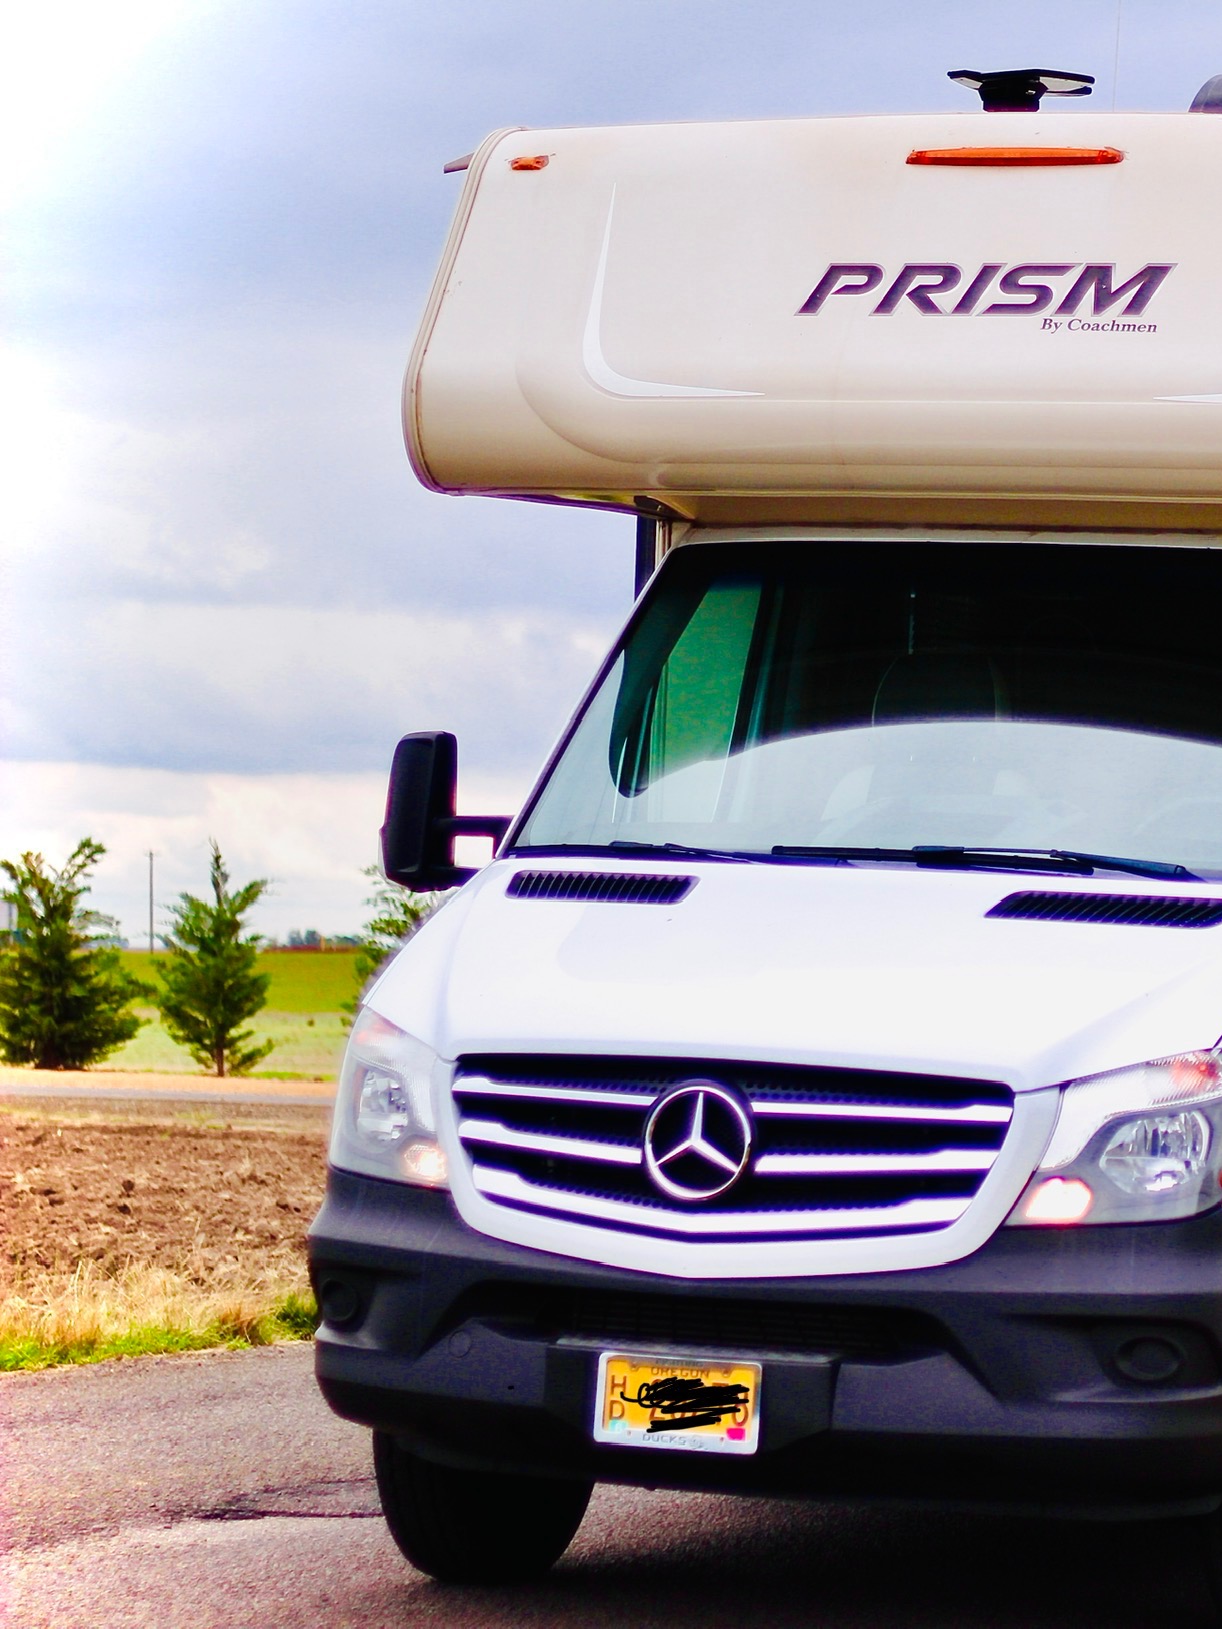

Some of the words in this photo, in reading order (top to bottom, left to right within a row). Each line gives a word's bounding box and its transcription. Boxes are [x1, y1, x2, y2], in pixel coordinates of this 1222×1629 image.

[794, 262, 1179, 317] PRISM
[1040, 318, 1063, 334] By
[1067, 318, 1158, 334] Coachmen
[651, 1367, 710, 1379] OREGON
[642, 1433, 687, 1446] DUCKS
